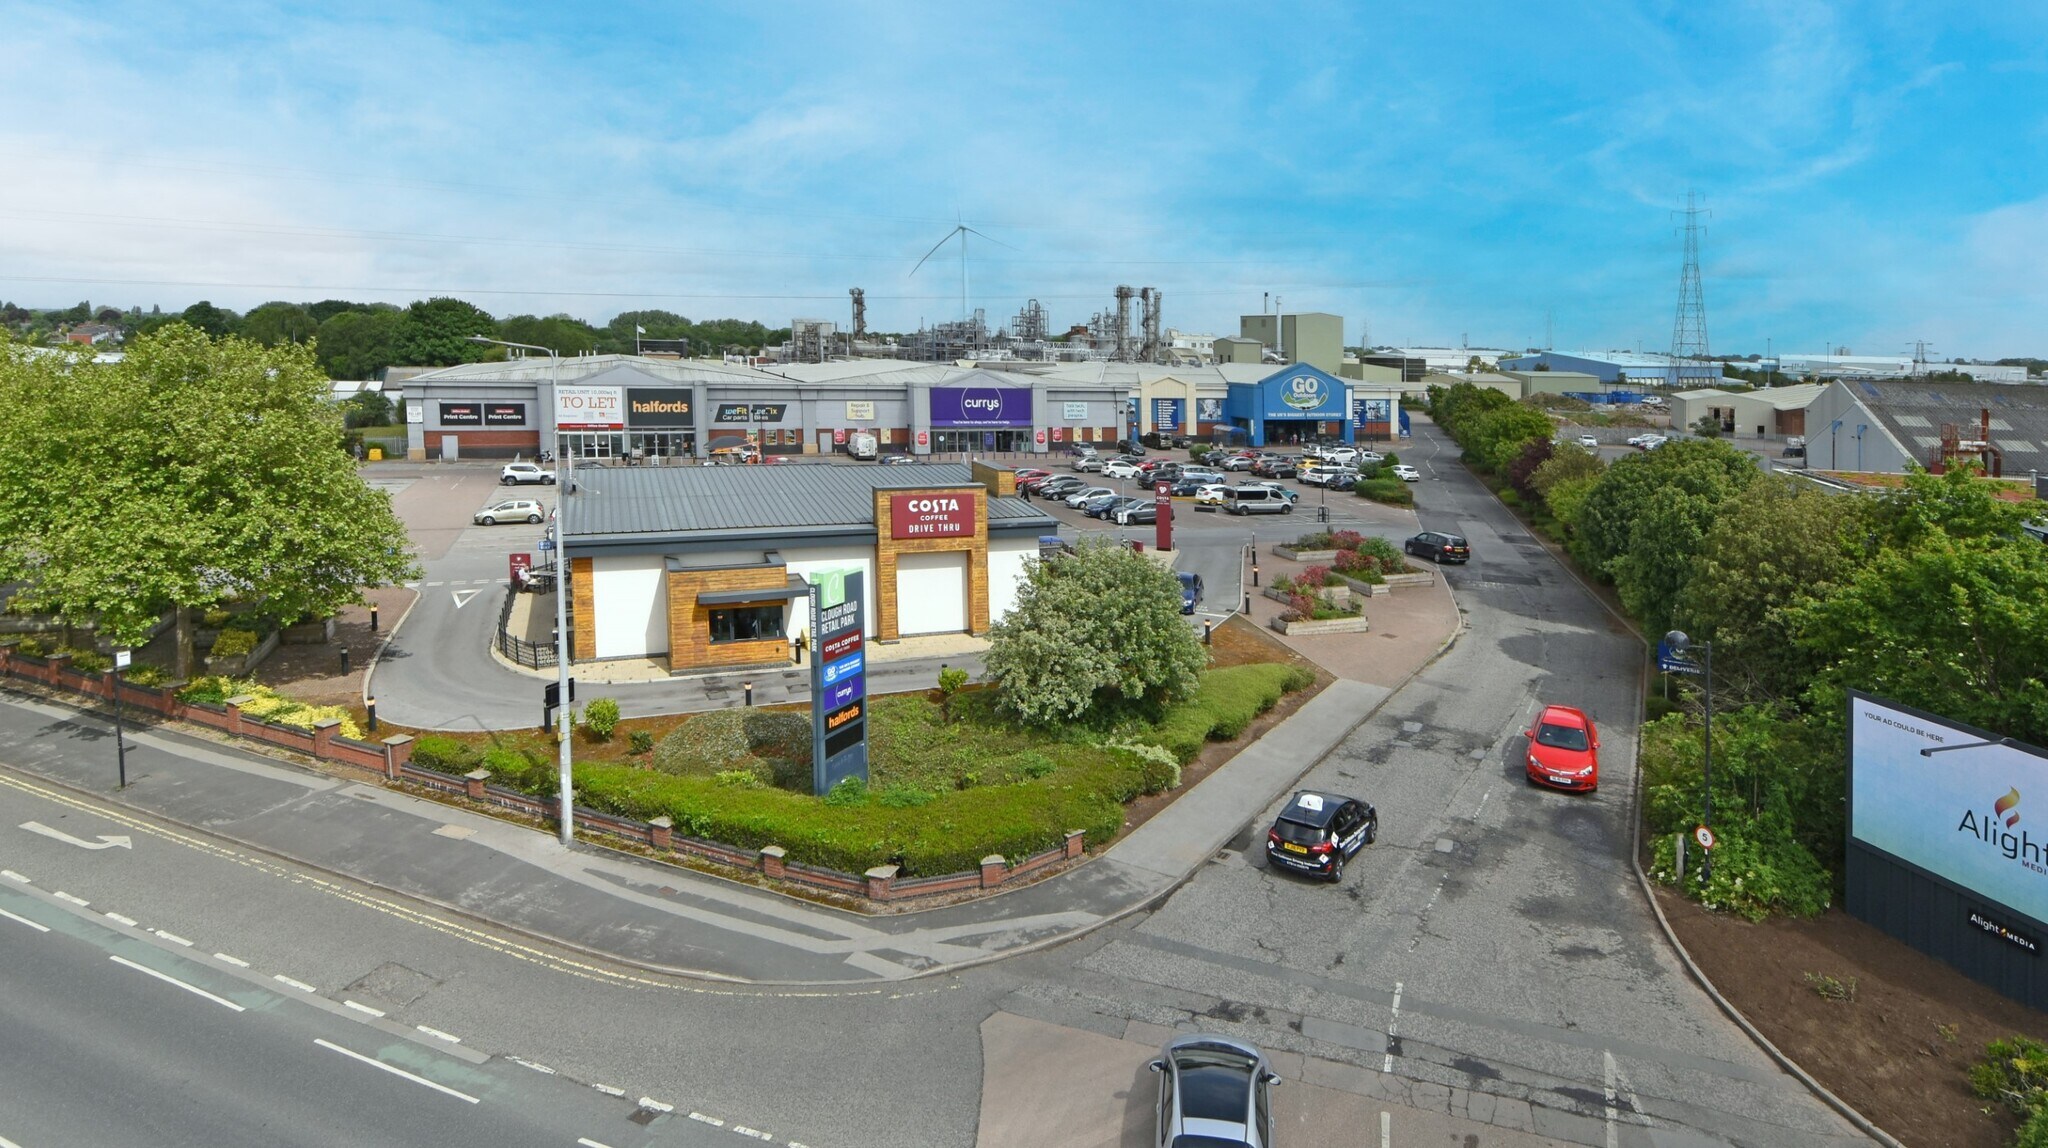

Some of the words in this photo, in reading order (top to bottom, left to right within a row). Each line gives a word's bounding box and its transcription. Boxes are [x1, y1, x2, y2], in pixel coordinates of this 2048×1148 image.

[1292, 377, 1318, 393] GO
[560, 396, 584, 409] TO
[588, 396, 617, 409] LET
[632, 400, 689, 413] halfords
[964, 398, 1000, 411] currys
[725, 406, 748, 415] weFit
[908, 499, 960, 513] COSTA
[920, 514, 948, 522] COFFEE
[908, 523, 935, 534] DRIVE
[938, 523, 961, 532] THRU
[821, 604, 843, 623] CLOUGH
[842, 600, 858, 616] ROAD
[821, 618, 841, 636] RETAIL
[840, 613, 856, 629] PARK
[824, 641, 841, 653] COSTA
[841, 634, 860, 647] COFFEE
[837, 686, 852, 698] currys
[828, 705, 860, 729] halfords
[1864, 711, 1882, 723] YOUR
[1883, 718, 1893, 726] AD
[1893, 721, 1915, 733] COULD
[1916, 728, 1925, 737] BE
[1926, 732, 1945, 743] HERE
[1702, 832, 1708, 841] 5
[1970, 913, 2000, 934] Alight
[2006, 931, 2036, 950] MEDIA
